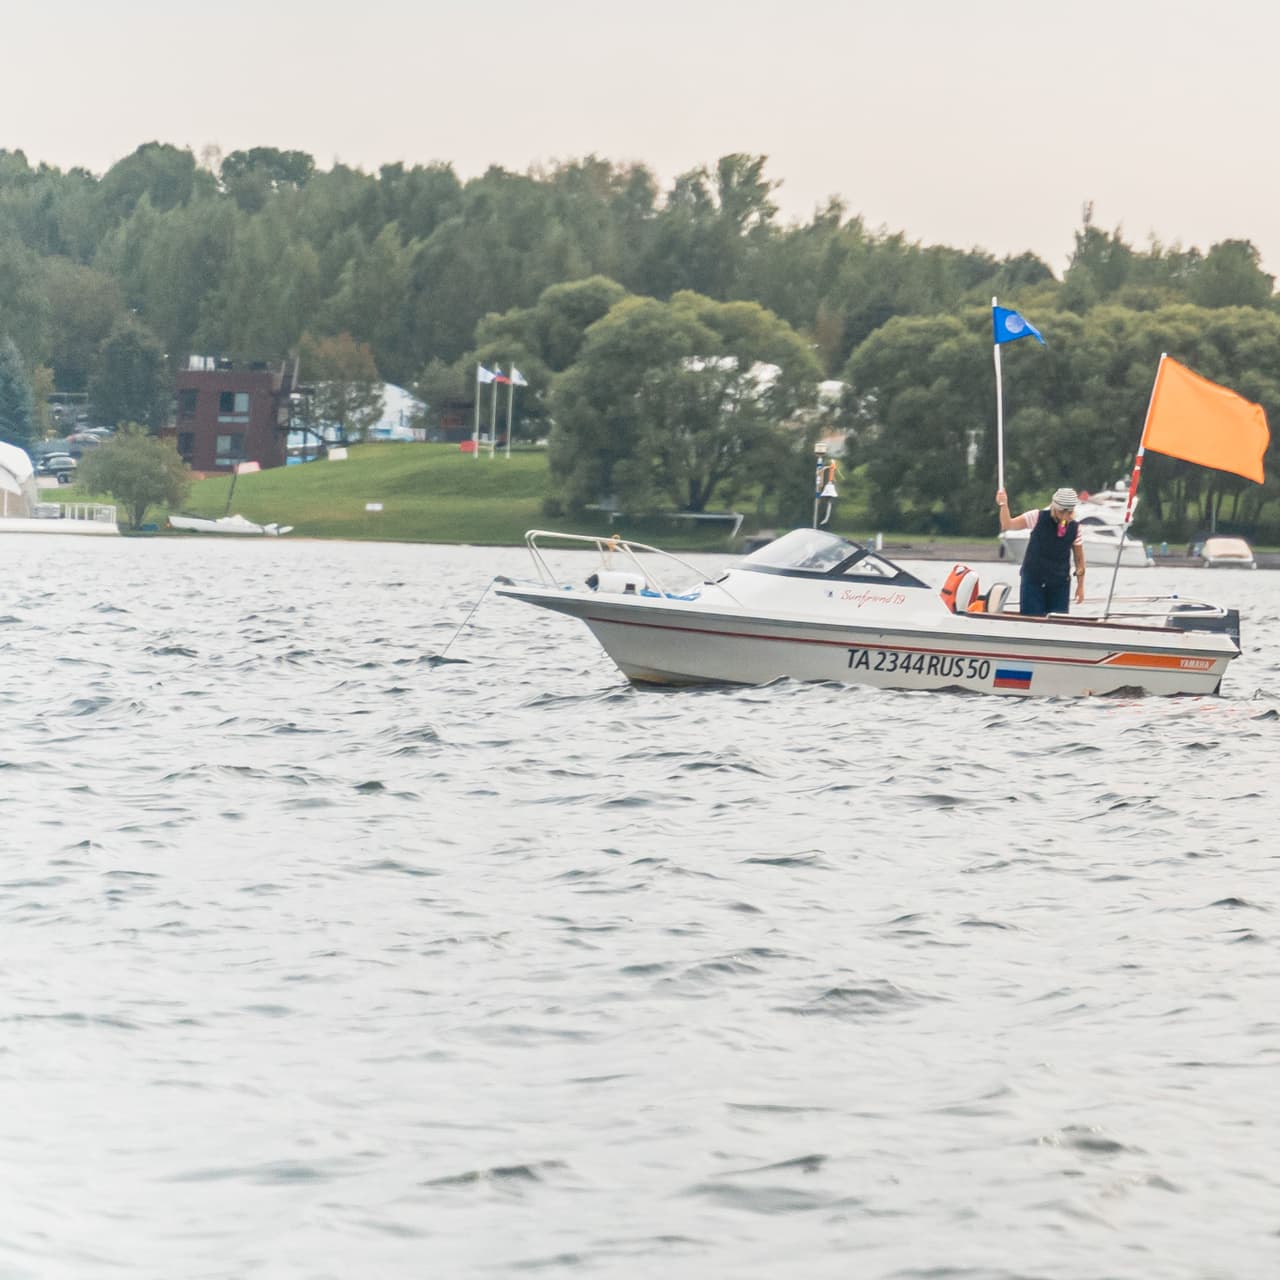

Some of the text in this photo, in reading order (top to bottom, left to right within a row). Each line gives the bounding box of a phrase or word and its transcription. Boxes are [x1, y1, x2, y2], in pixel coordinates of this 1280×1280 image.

[848, 649, 991, 680] TA 2344 RUS 50
[1180, 659, 1210, 669] YAMAHA
